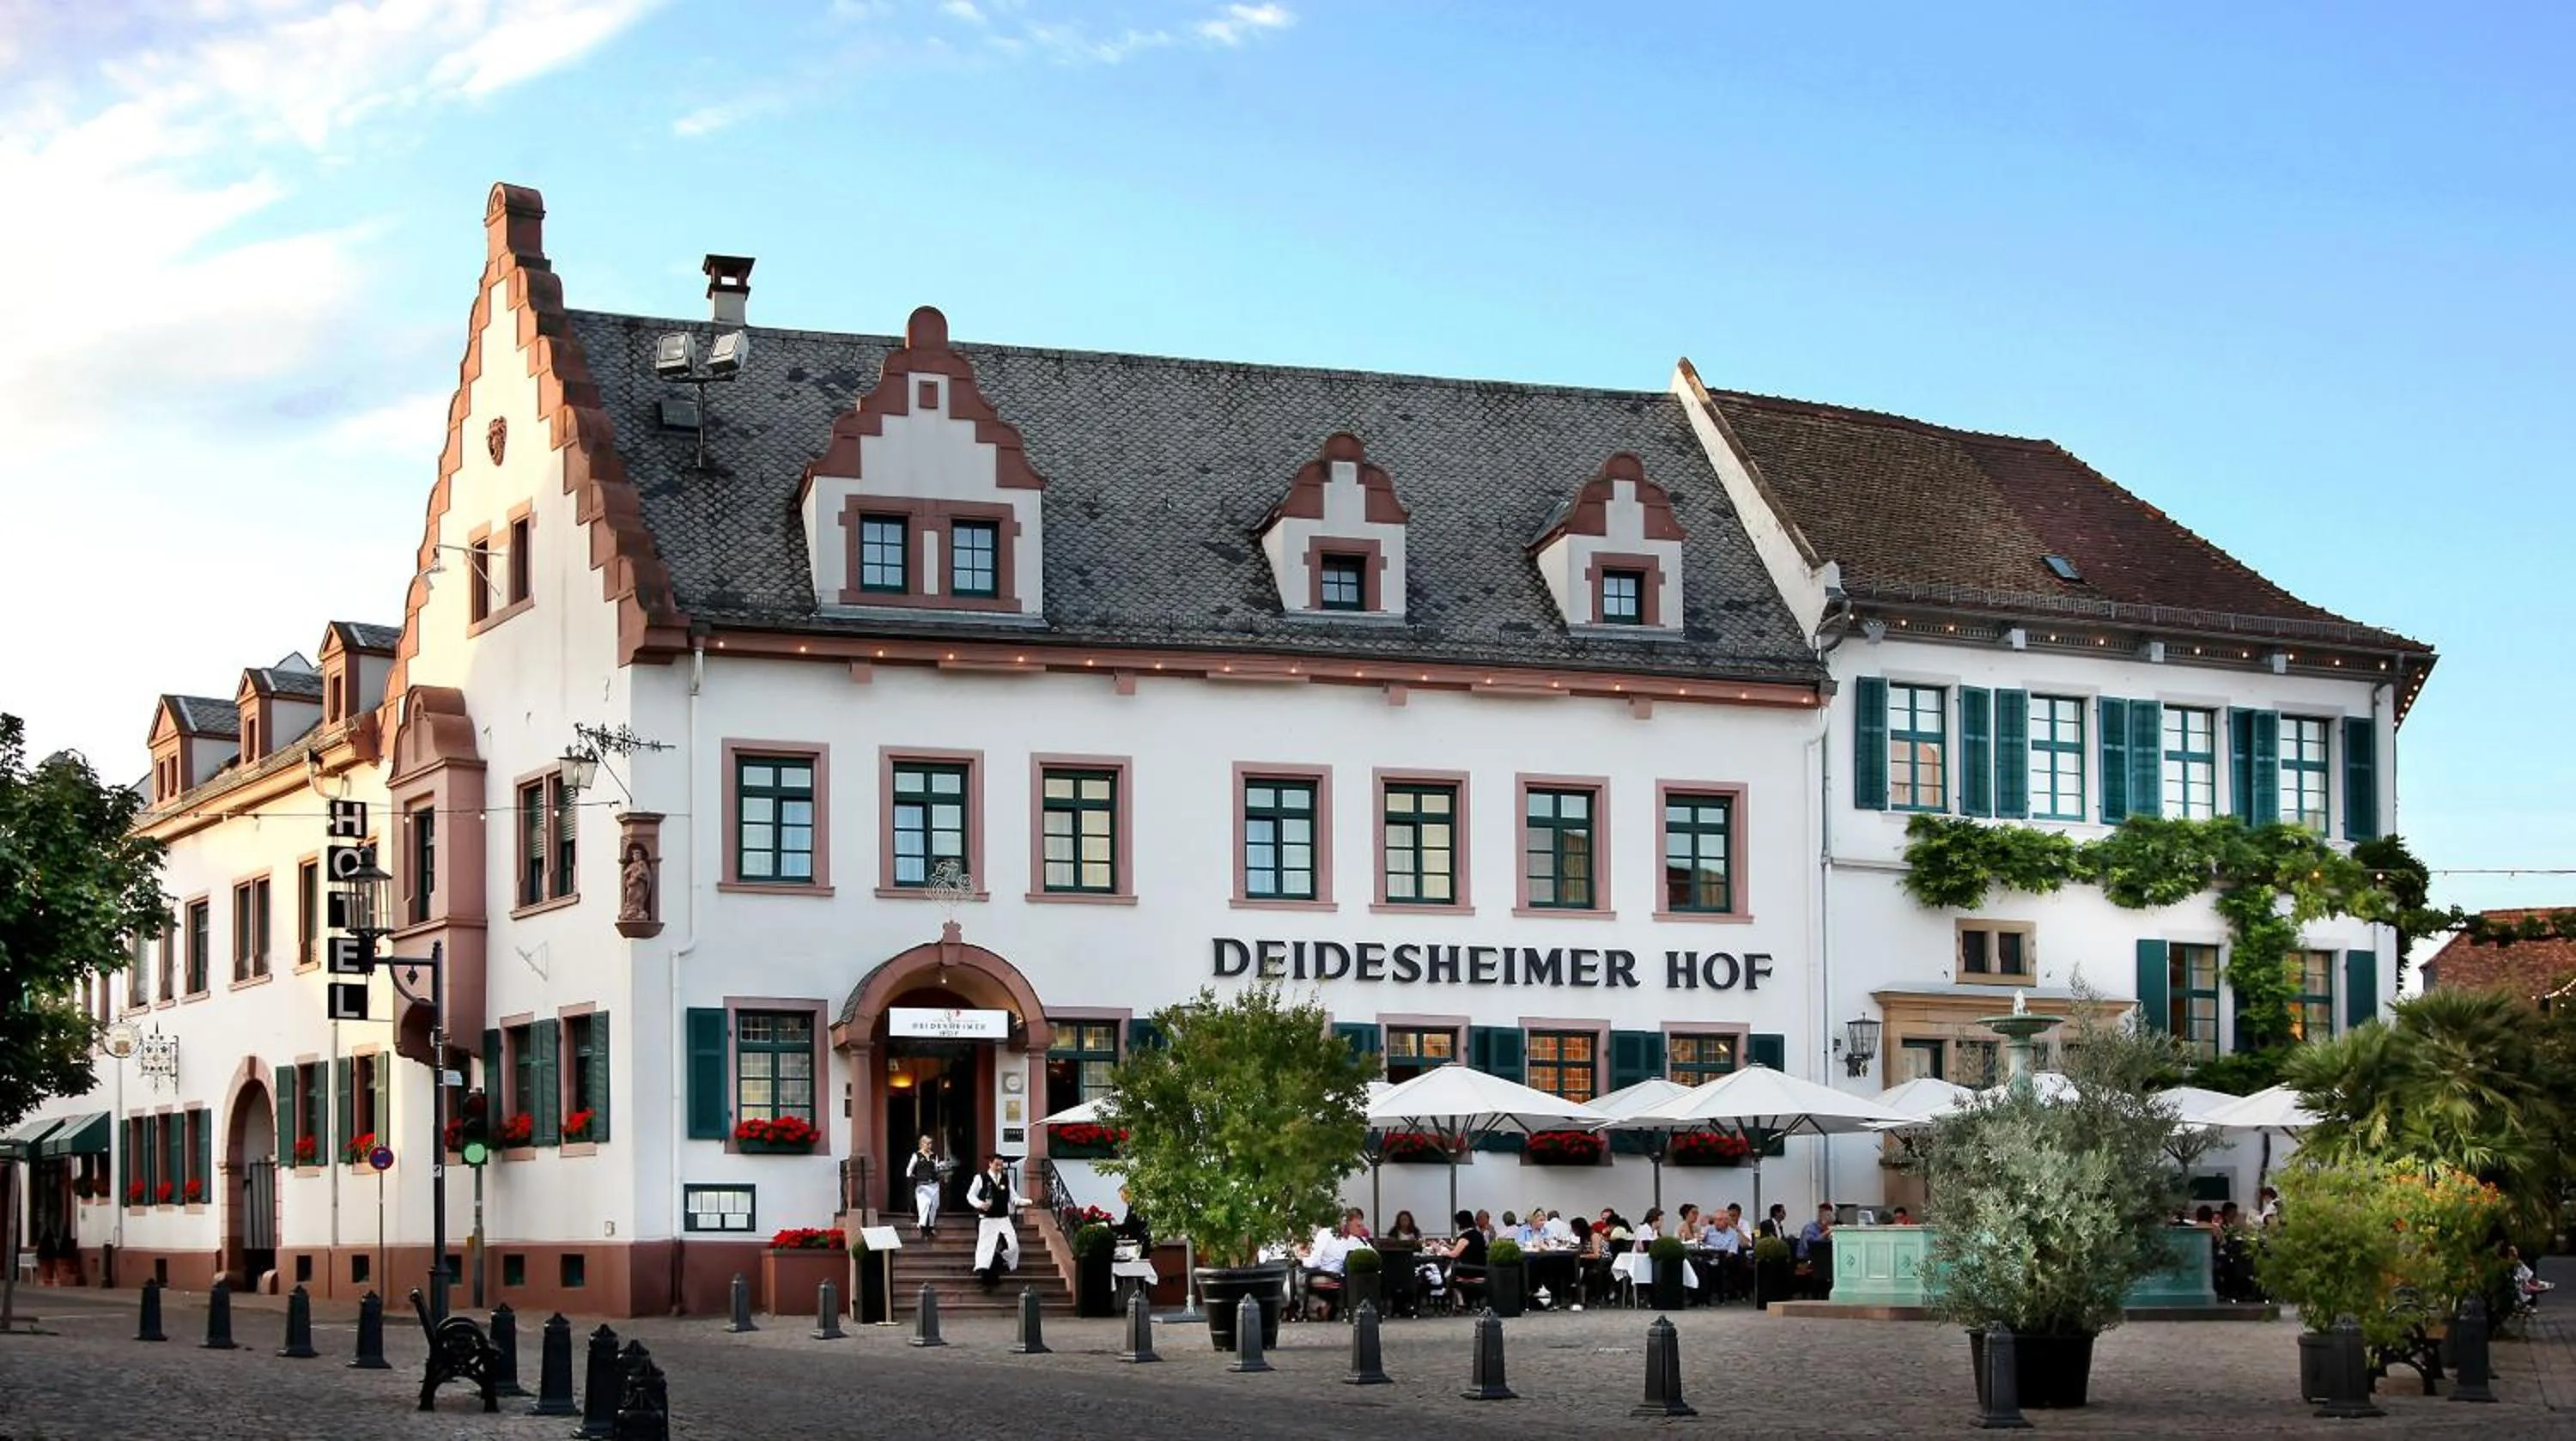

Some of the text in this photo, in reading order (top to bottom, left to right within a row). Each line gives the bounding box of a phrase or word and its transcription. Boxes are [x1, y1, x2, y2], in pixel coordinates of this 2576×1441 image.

[333, 802, 362, 1018] HOTEL
[1212, 938, 1773, 990] DEIDESHEIMER HOF
